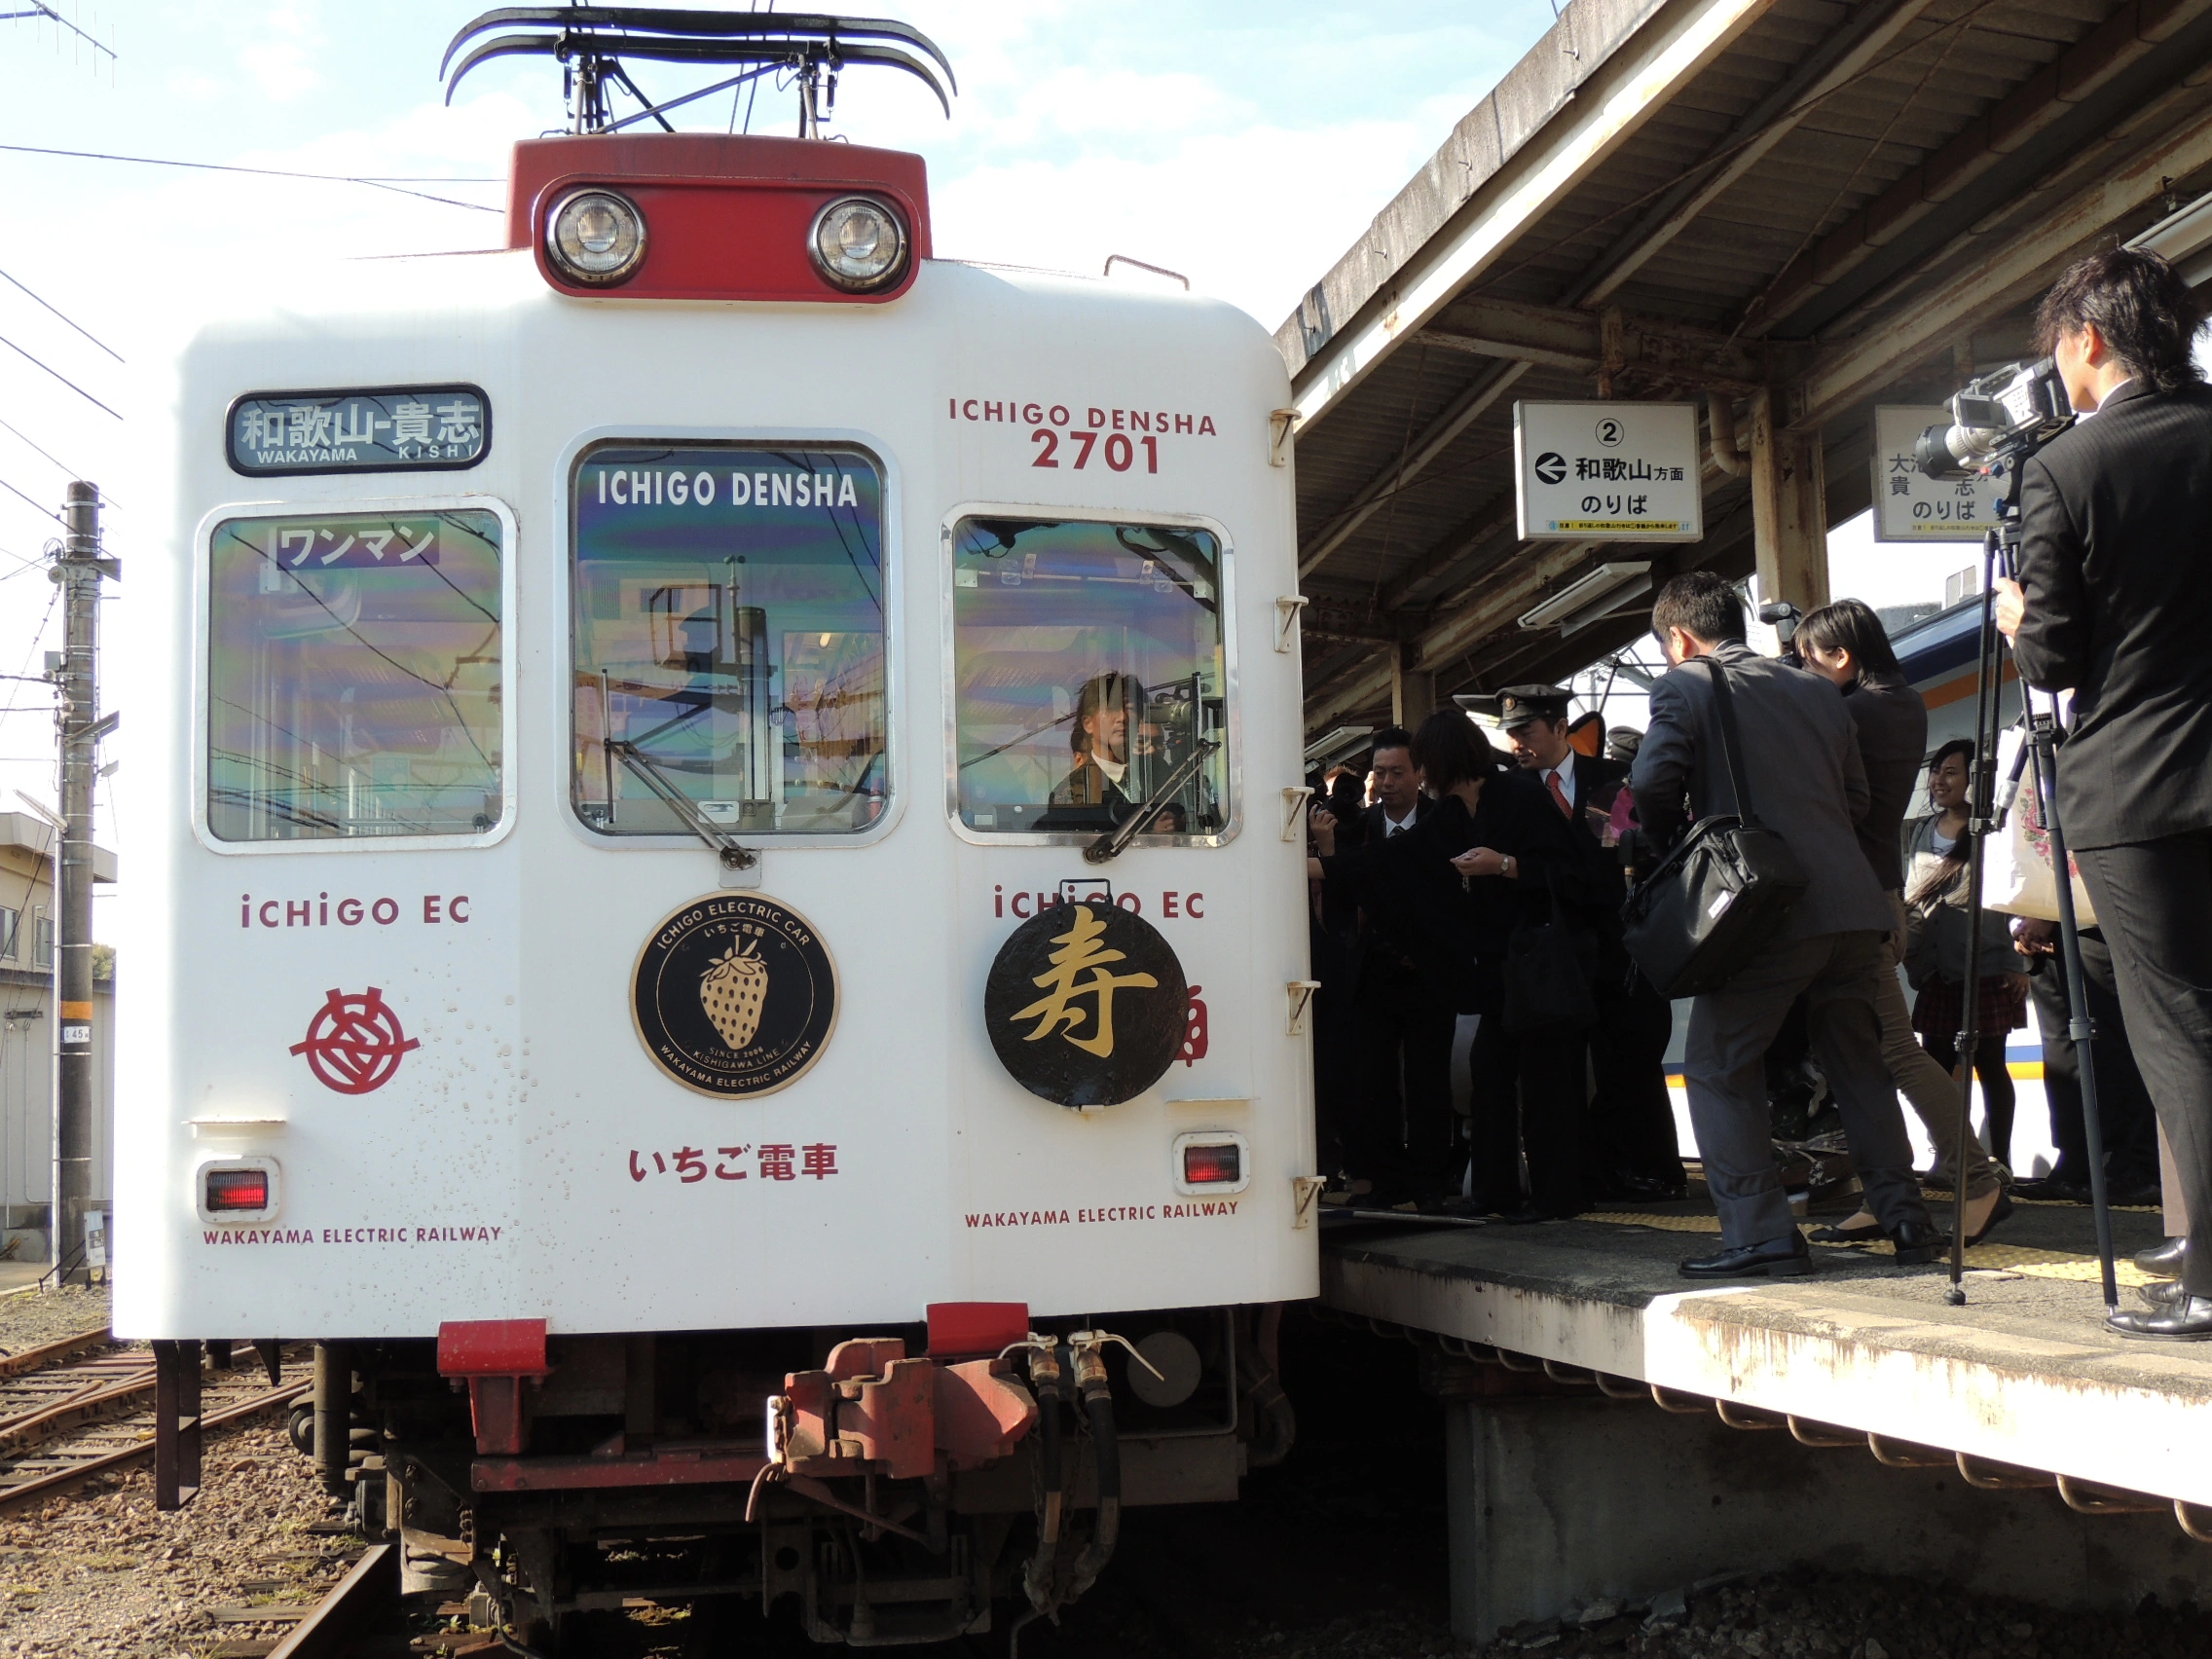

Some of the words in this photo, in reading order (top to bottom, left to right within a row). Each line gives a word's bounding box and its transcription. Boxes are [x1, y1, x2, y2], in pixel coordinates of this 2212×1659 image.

[948, 397, 1071, 427] ICHIGO
[1088, 407, 1217, 437] DENSHA
[257, 446, 358, 464] WAKAYAMA
[398, 444, 473, 461] KISHI
[1030, 428, 1159, 475] 2701
[1574, 457, 1684, 482] 和歌山方面
[599, 470, 716, 507] ICHIGO
[732, 472, 859, 508] DENSHA
[1581, 494, 1648, 515] のりば
[1912, 500, 1976, 521] のりば
[280, 526, 435, 567] ワンマン
[423, 894, 470, 925] EC
[1161, 891, 1205, 919] EC
[656, 909, 704, 950] ICHIGO
[708, 902, 782, 924] ELECTRIC
[784, 920, 810, 946] CAR
[704, 922, 765, 939] いちご電車
[1009, 904, 1159, 1058] 寿
[660, 1044, 713, 1084] WAKAYAMA
[716, 1073, 772, 1088] ELECTRIC
[774, 1040, 813, 1078] RAILWAY
[692, 1050, 754, 1070] KISHIGAWA
[756, 1048, 781, 1065] LINE
[709, 1046, 740, 1059] SINCE
[628, 1142, 839, 1184] いちご電車
[964, 1208, 1071, 1228] WAKAYAMA
[1077, 1204, 1156, 1224] ELECTRIC
[1161, 1200, 1239, 1219] RAILWAY
[203, 1229, 315, 1246] WAKAYAMA
[322, 1227, 409, 1244] ELECTRIC
[415, 1226, 503, 1243] RAILWAY
